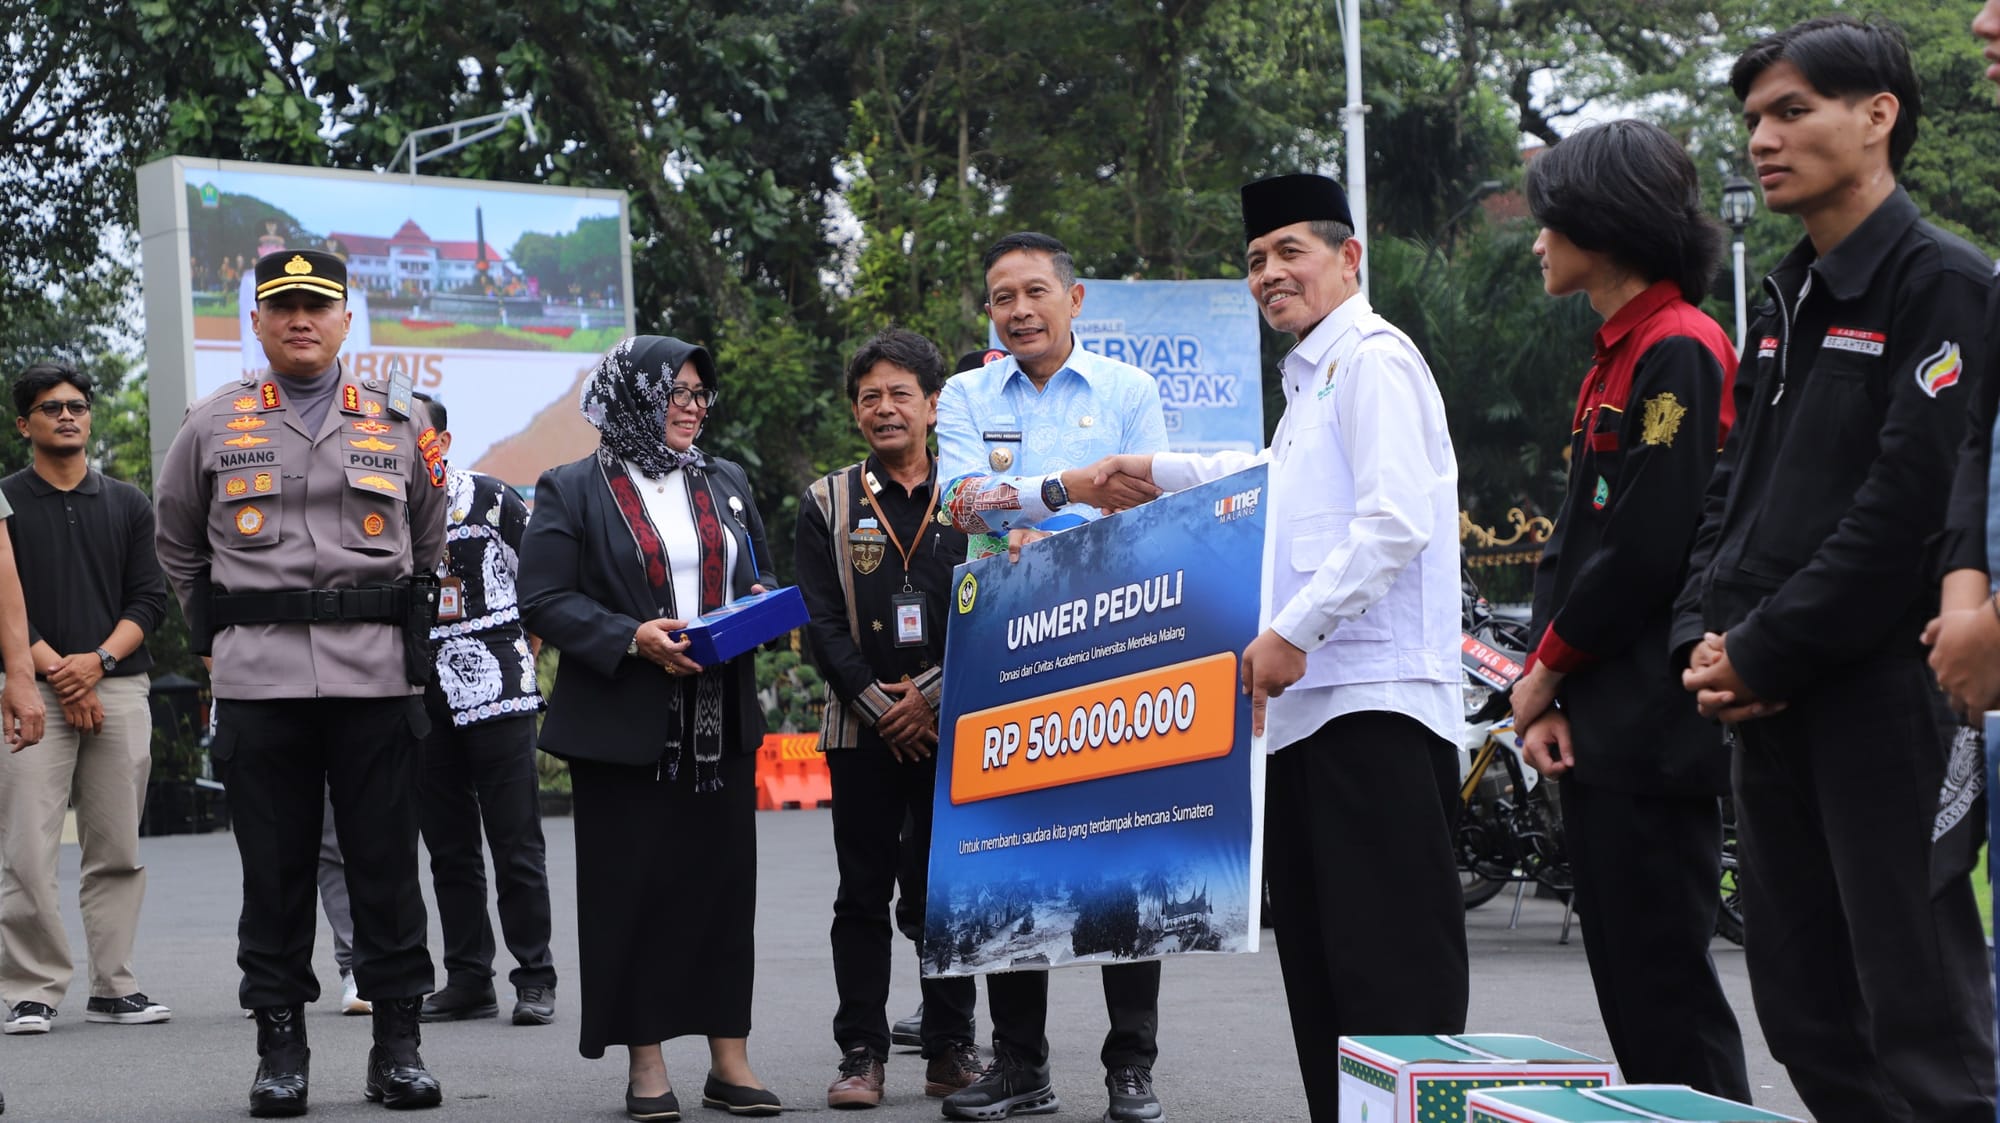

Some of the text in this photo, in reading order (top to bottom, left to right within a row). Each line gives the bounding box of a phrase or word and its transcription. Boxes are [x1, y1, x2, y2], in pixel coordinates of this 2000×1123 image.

[1075, 322, 1122, 334] EMBALI
[1082, 339, 1198, 368] EBYAR
[342, 352, 444, 388] BOIS
[1159, 379, 1234, 403] AJAK
[220, 451, 275, 468] NANANG
[350, 454, 397, 470] POLRI
[1220, 505, 1255, 523] MALANG
[1007, 569, 1184, 650] UNMER PEDULI
[999, 626, 1185, 683] Donasi dari Civitas Academica Universitas Merdeka Malang
[982, 682, 1196, 770] RP 50.000.000
[958, 802, 1214, 855] Untuk membantu saudara kita yang terdampak bencana Sumatera
